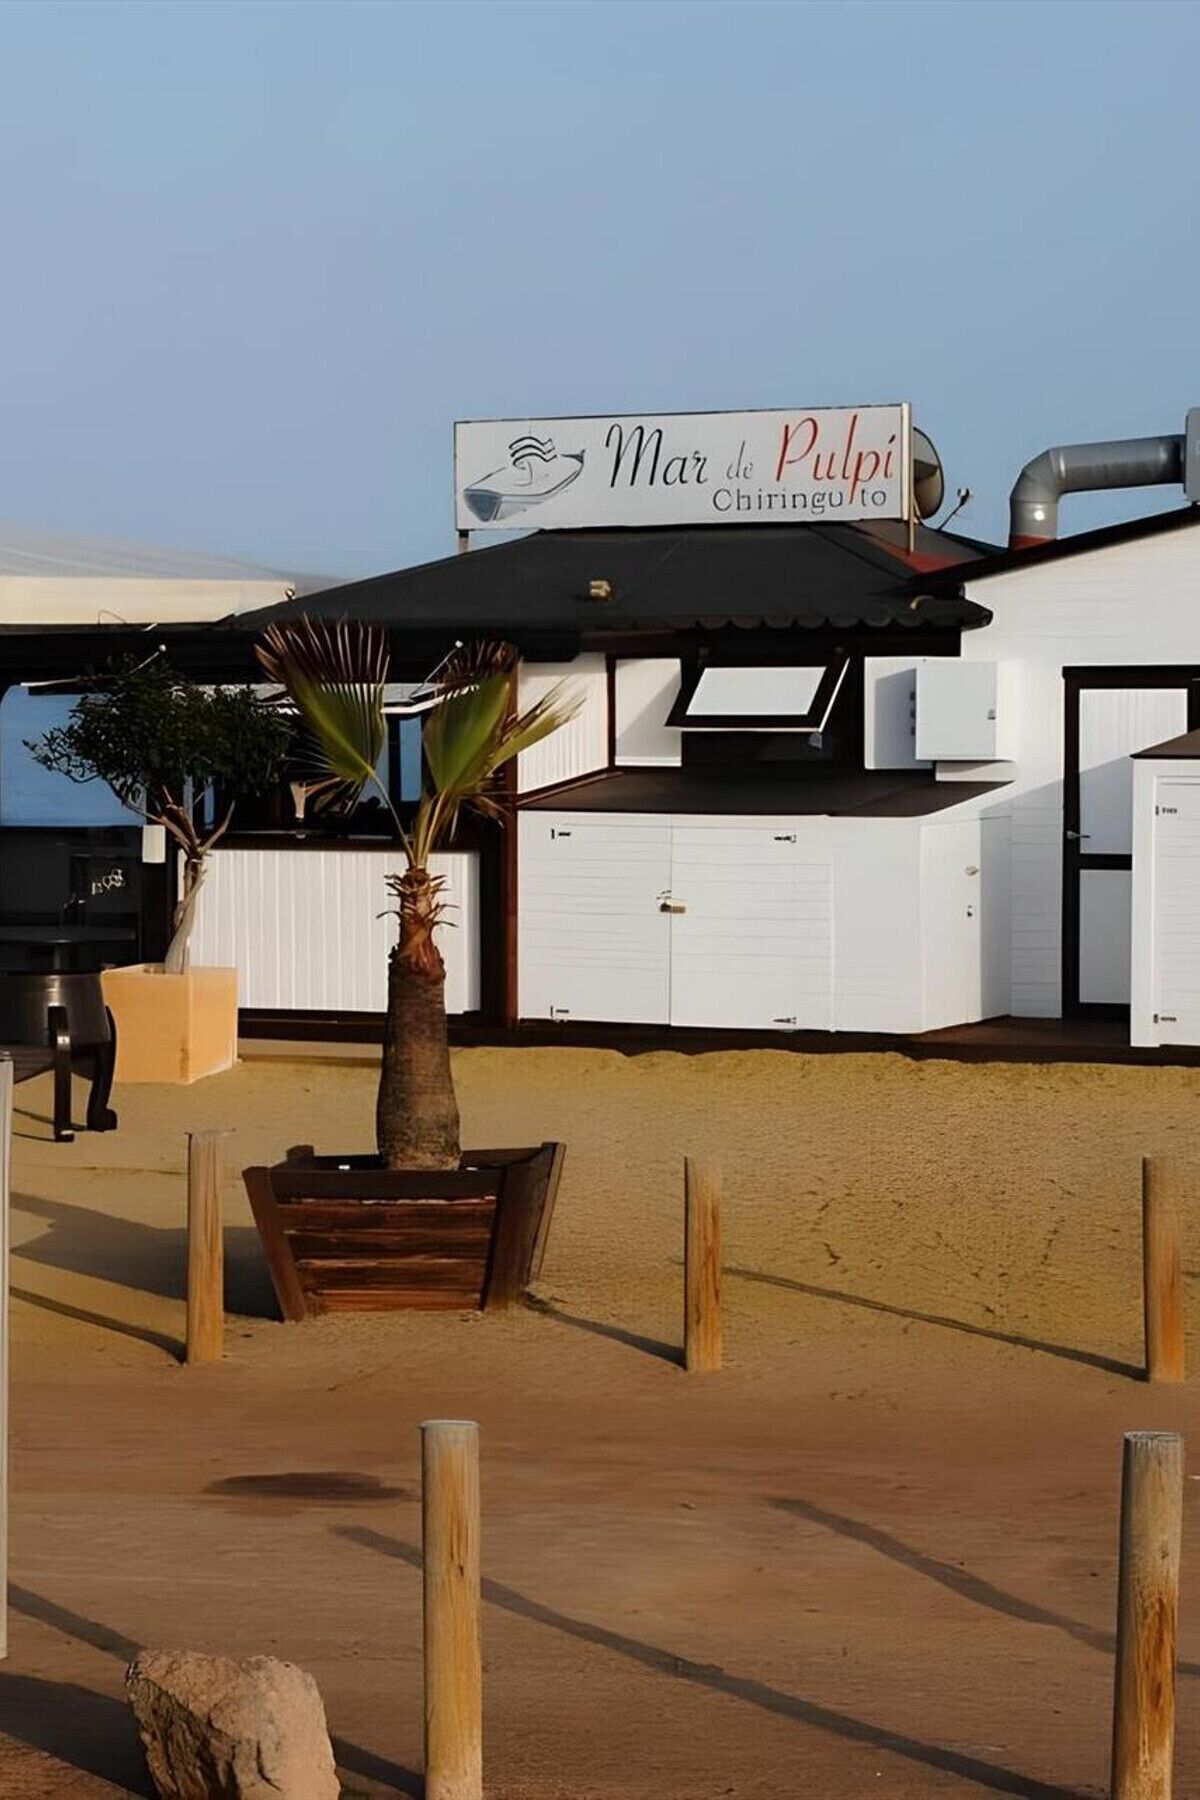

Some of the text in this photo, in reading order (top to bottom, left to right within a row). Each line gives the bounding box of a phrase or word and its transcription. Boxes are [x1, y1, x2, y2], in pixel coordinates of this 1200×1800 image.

[605, 413, 897, 505] Mar de Pulpí
[712, 487, 888, 515] Chiringuto
